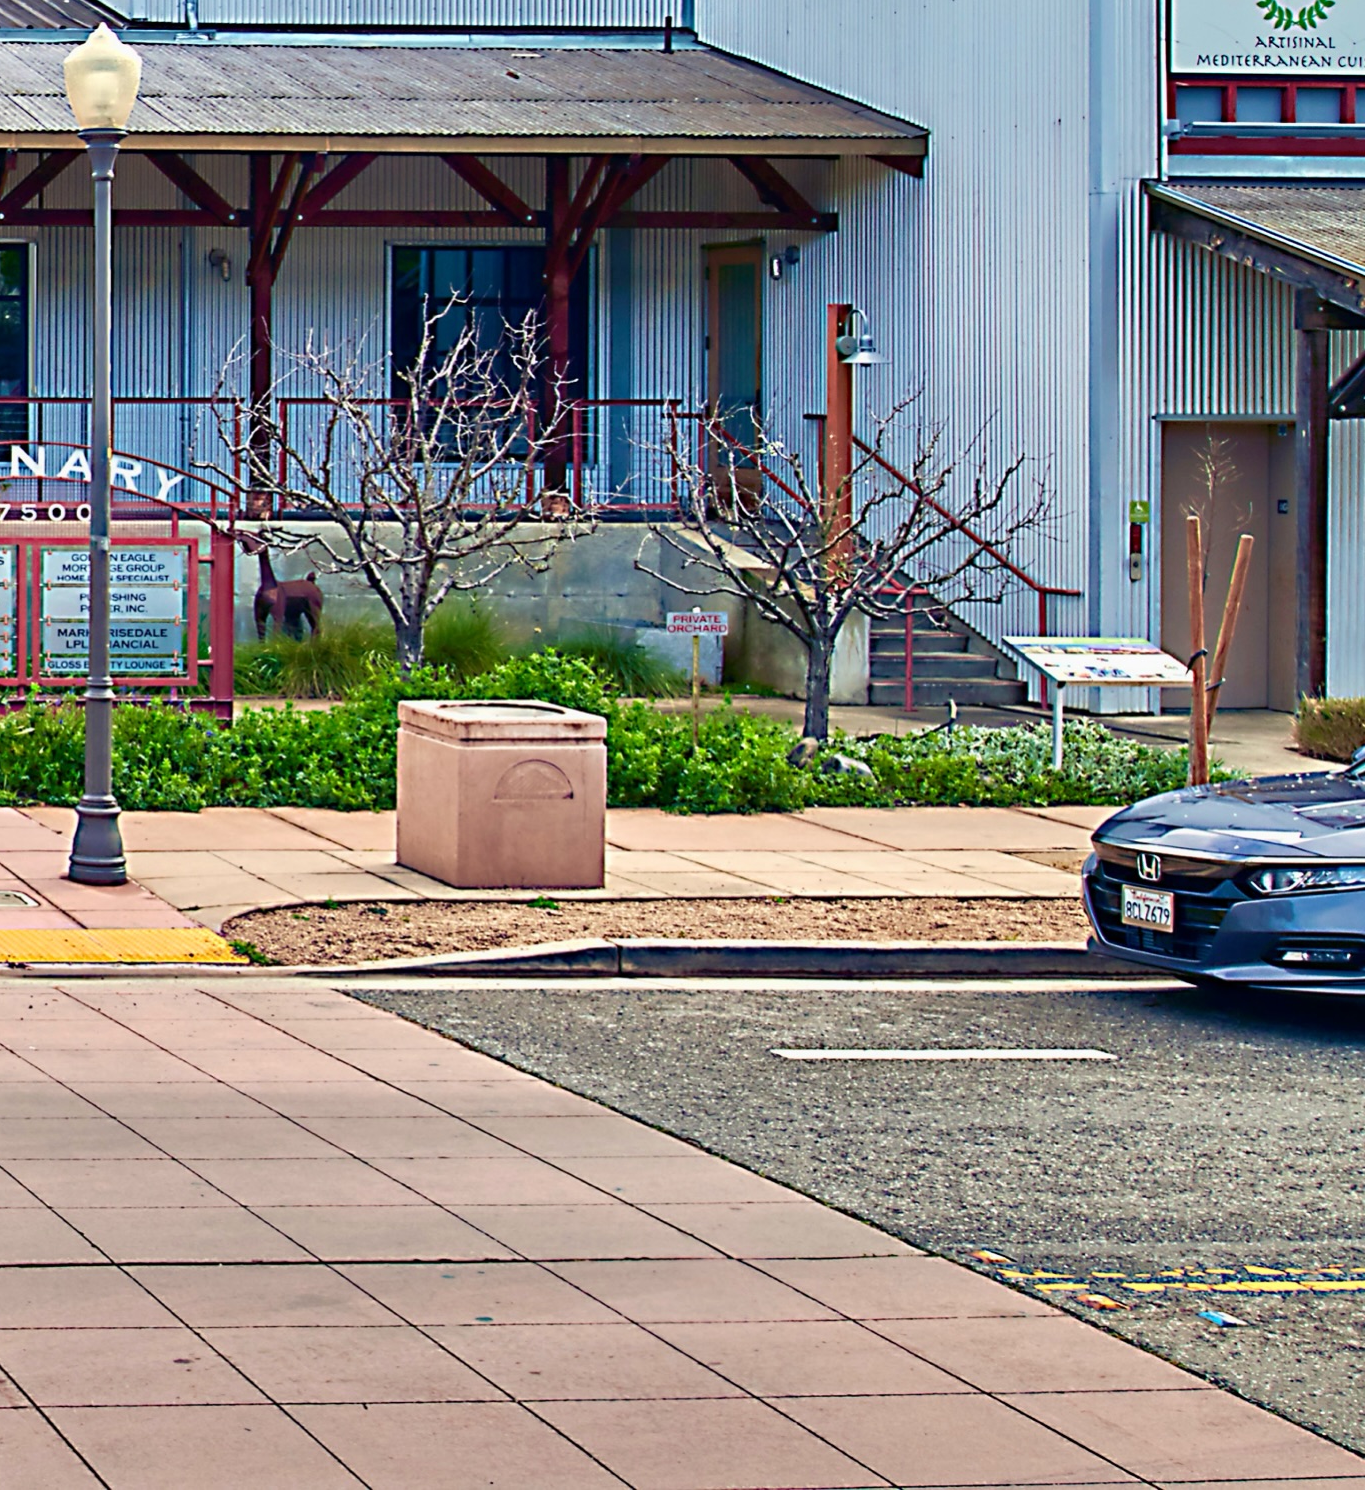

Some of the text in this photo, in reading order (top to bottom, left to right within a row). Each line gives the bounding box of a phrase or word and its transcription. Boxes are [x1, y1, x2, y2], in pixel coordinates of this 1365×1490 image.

[1254, 36, 1336, 49] ARTISINAL
[1196, 54, 1365, 68] MEDITERRANEAN CUI
[120, 553, 156, 562] EAGLE
[126, 564, 165, 572] GROUP
[116, 574, 170, 582] SPECIALIST
[672, 615, 721, 623] PRIVATE
[108, 629, 168, 637] RISEDALE
[667, 624, 728, 633] ORCHARD
[66, 640, 89, 649] LPL
[48, 661, 82, 669] GLOSS
[124, 661, 166, 669] LOUNGE
[1126, 901, 1170, 925] 8CLZ679
